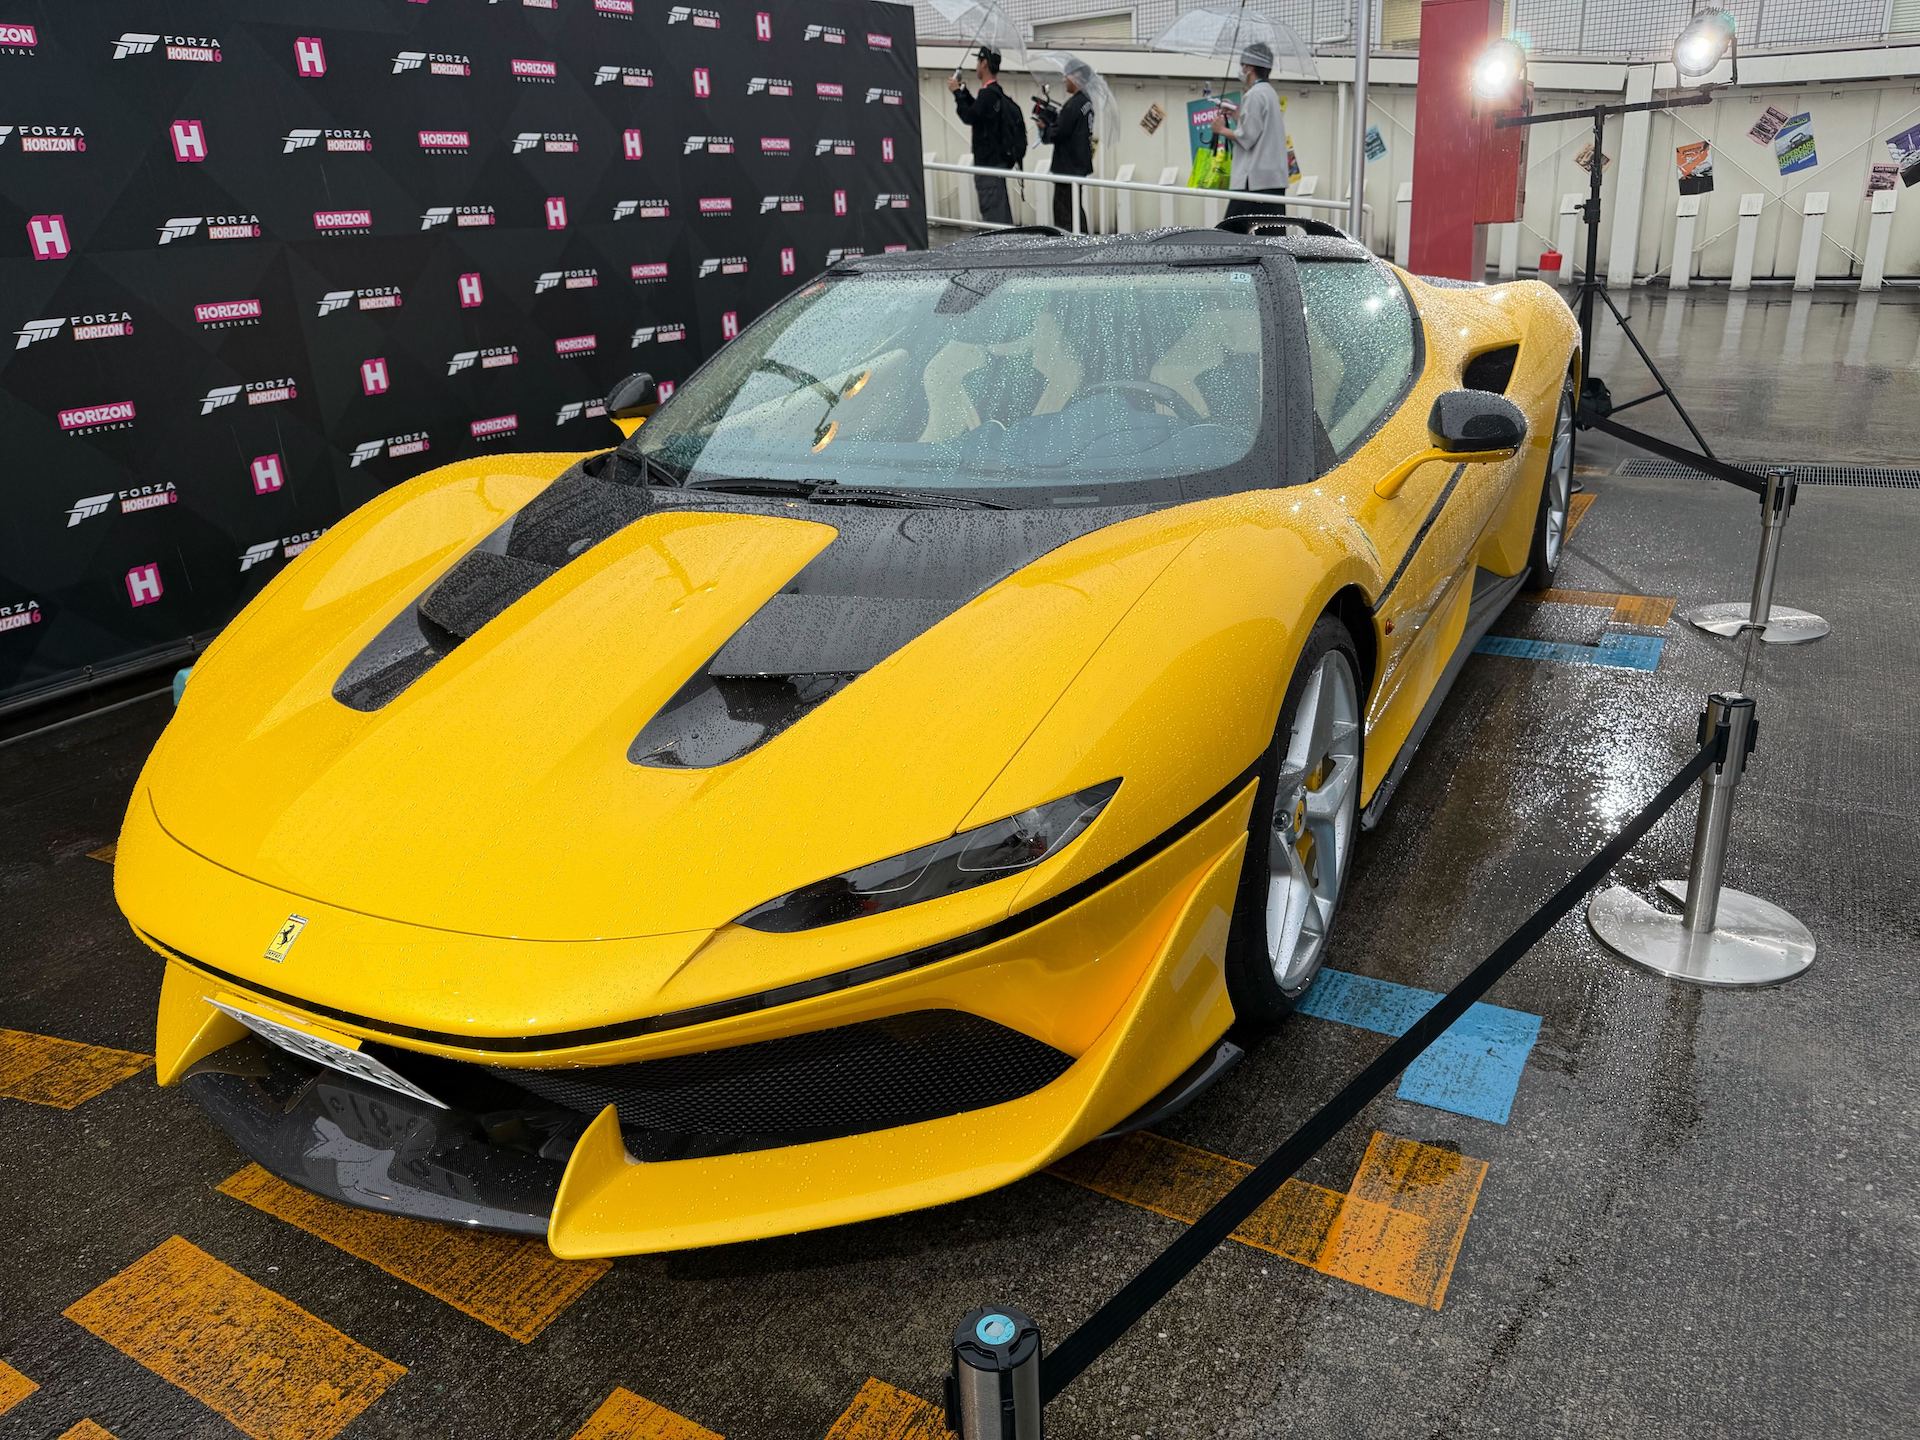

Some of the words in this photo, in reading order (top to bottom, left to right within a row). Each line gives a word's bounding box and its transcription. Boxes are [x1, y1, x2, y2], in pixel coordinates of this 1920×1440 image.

[595, 0, 633, 12] HORIZON
[692, 8, 720, 18] FORZA
[756, 14, 771, 39] H
[0, 27, 34, 44] ZON
[164, 35, 220, 48] FORZA
[1, 48, 35, 56] IVAL
[167, 47, 213, 62] HORIZON
[213, 51, 222, 62] 6
[296, 41, 324, 73] H
[429, 53, 470, 64] FORZA
[431, 63, 464, 75] HORIZON
[464, 66, 471, 76] 6
[513, 62, 555, 75] HORIZON
[622, 67, 653, 76] FORZA
[517, 76, 555, 84] FESTIVAL
[693, 71, 710, 95] H
[18, 126, 84, 136] FORZA
[325, 129, 371, 138] FORZA
[544, 133, 578, 141] FORZA
[22, 138, 76, 152] HORIZON
[77, 138, 86, 152] 6
[173, 125, 204, 157] H
[327, 139, 365, 151] HORIZON
[365, 139, 372, 152] 6
[420, 133, 467, 145] HORIZON
[624, 133, 641, 157] H
[882, 139, 894, 160] H
[834, 192, 847, 213] H
[456, 206, 494, 214] FORZA
[546, 200, 566, 226] H
[206, 215, 259, 225] FORZA
[316, 213, 369, 227] HORIZON
[457, 215, 490, 227] HORIZON
[31, 220, 67, 254] H
[208, 225, 252, 239] HORIZON
[252, 225, 261, 238] 6
[321, 228, 370, 236] FESTIVAL
[781, 250, 794, 273] H
[565, 269, 597, 278] FORZA
[632, 265, 667, 278] HORIZON
[357, 286, 401, 297] FORZA
[359, 296, 395, 310] HORIZON
[197, 302, 259, 320] HORIZON
[71, 312, 131, 325] FORZA
[203, 319, 260, 330] FESTIVAL
[73, 324, 124, 341] HORIZON
[124, 322, 133, 335] 6
[657, 323, 685, 332] FORZA
[723, 314, 737, 338] H
[481, 346, 518, 357] FORZA
[556, 337, 595, 352] HORIZON
[363, 362, 387, 391] H
[245, 378, 296, 392] FORZA
[248, 388, 288, 405] HORIZON
[288, 386, 297, 399] 6
[62, 404, 133, 426] HORIZON
[69, 422, 133, 437] FESTIVAL
[472, 416, 516, 433] HORIZON
[387, 432, 429, 446] FORZA
[476, 431, 516, 442] FESTIVAL
[389, 441, 423, 457] HORIZON
[423, 439, 430, 450] 6
[253, 459, 281, 490] H
[118, 482, 176, 499] FORZA
[121, 493, 169, 513] HORIZON
[169, 491, 177, 504] 6
[128, 568, 160, 602] H
[1, 600, 39, 616] RZA
[0, 613, 31, 632] RIZON
[31, 609, 42, 623] 6
